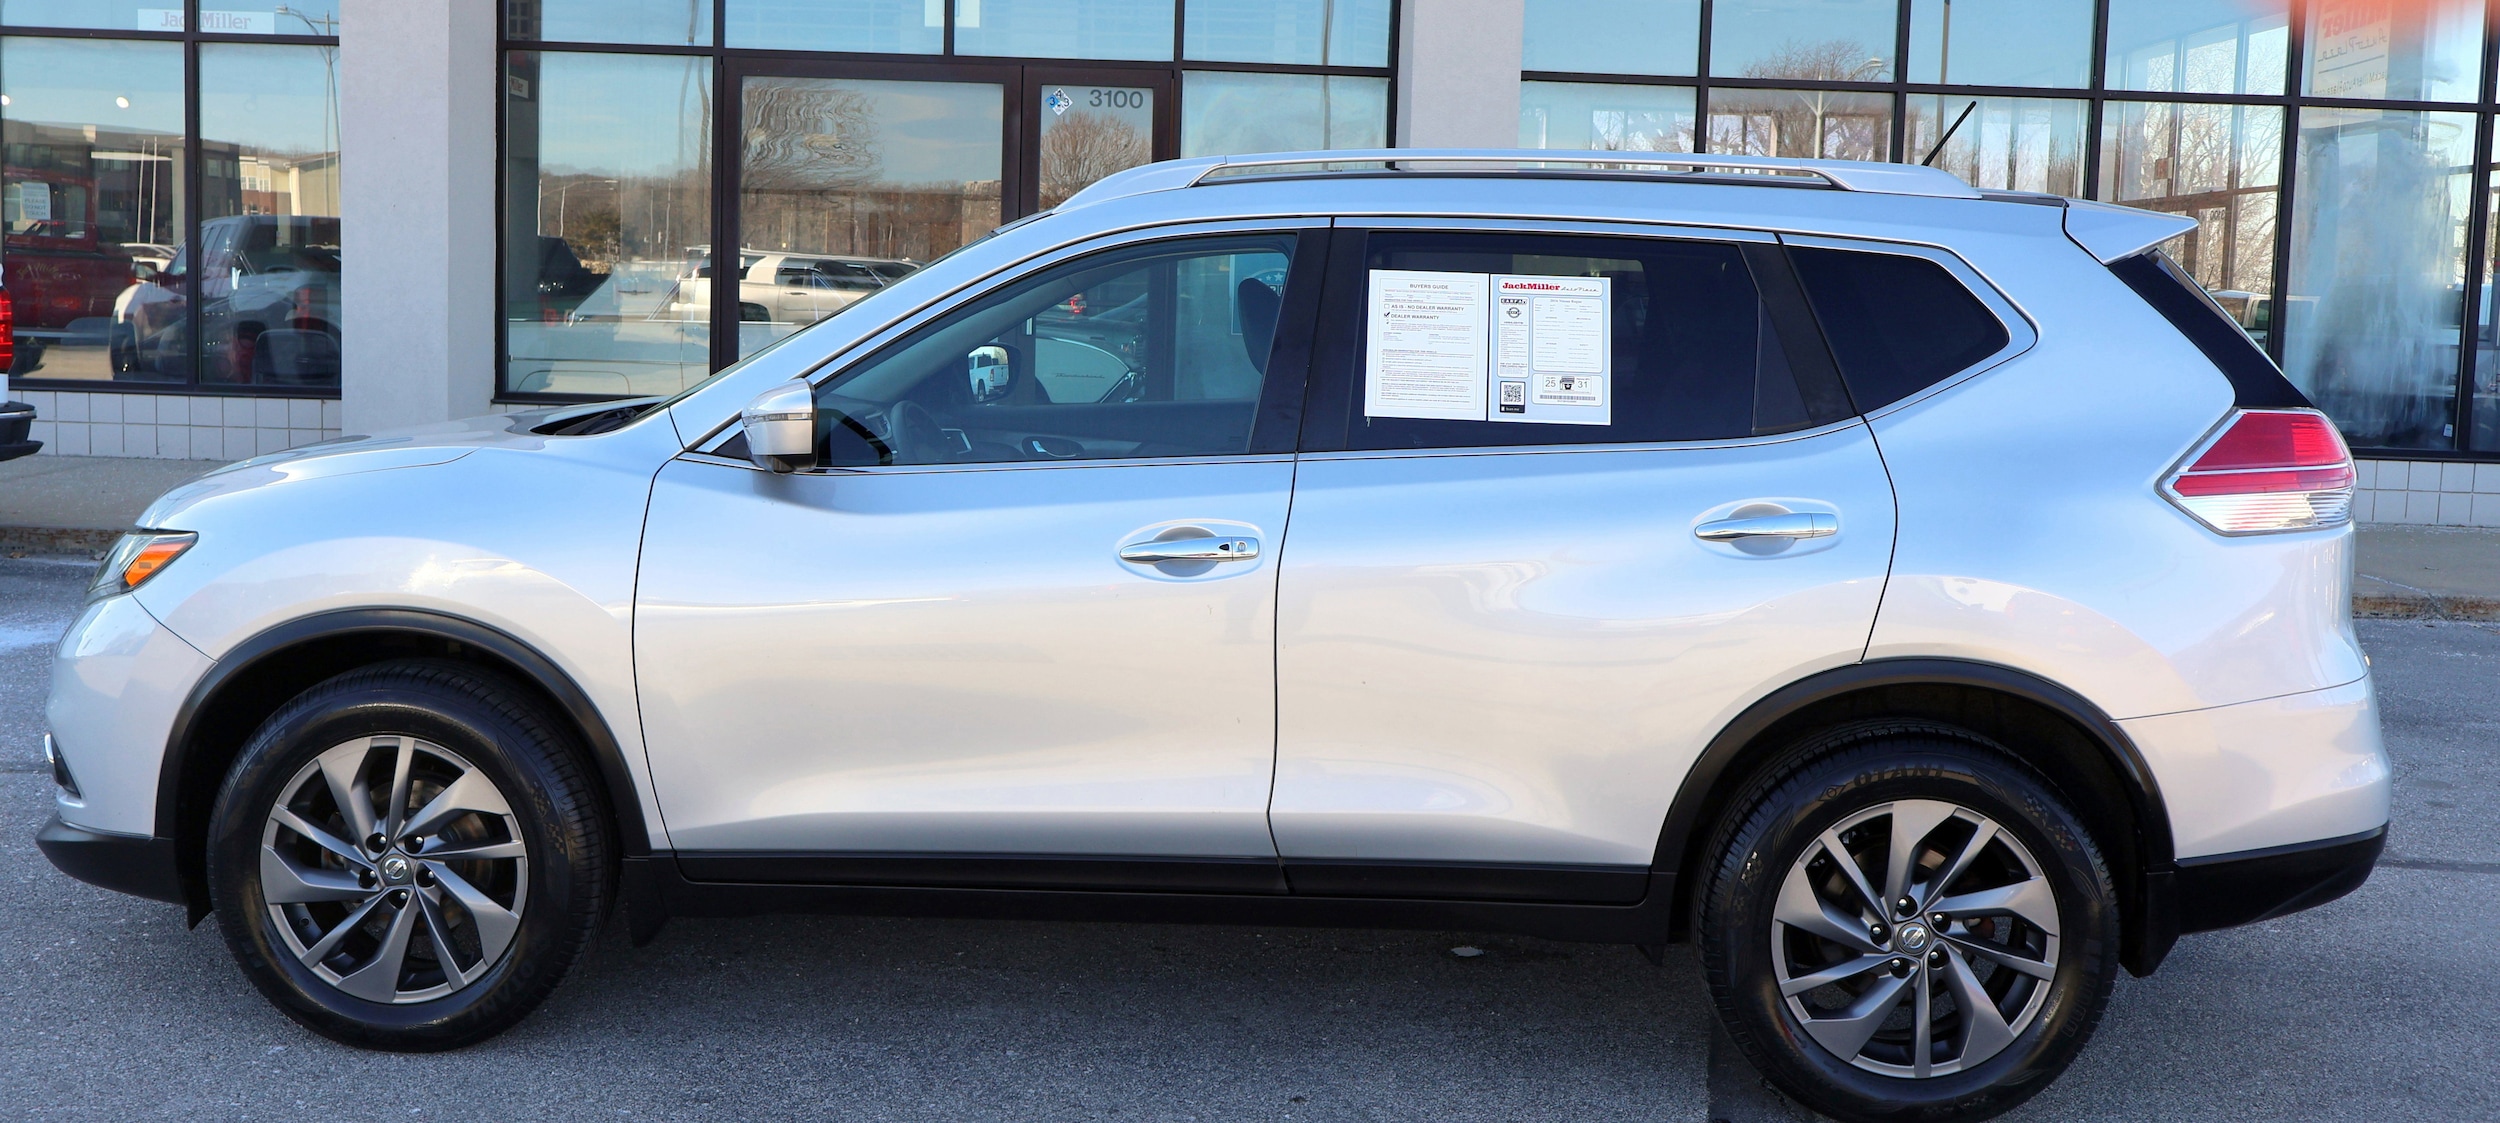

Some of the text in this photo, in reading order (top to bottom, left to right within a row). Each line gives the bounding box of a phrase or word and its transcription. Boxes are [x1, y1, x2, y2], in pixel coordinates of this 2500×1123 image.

[201, 13, 251, 30] Miller
[1049, 97, 1056, 106] 3
[1064, 98, 1070, 107] 3
[1089, 89, 1144, 109] 3100
[1502, 282, 1561, 291] JackMiller
[1545, 380, 1557, 388] 25
[1854, 762, 1944, 787] OTANI
